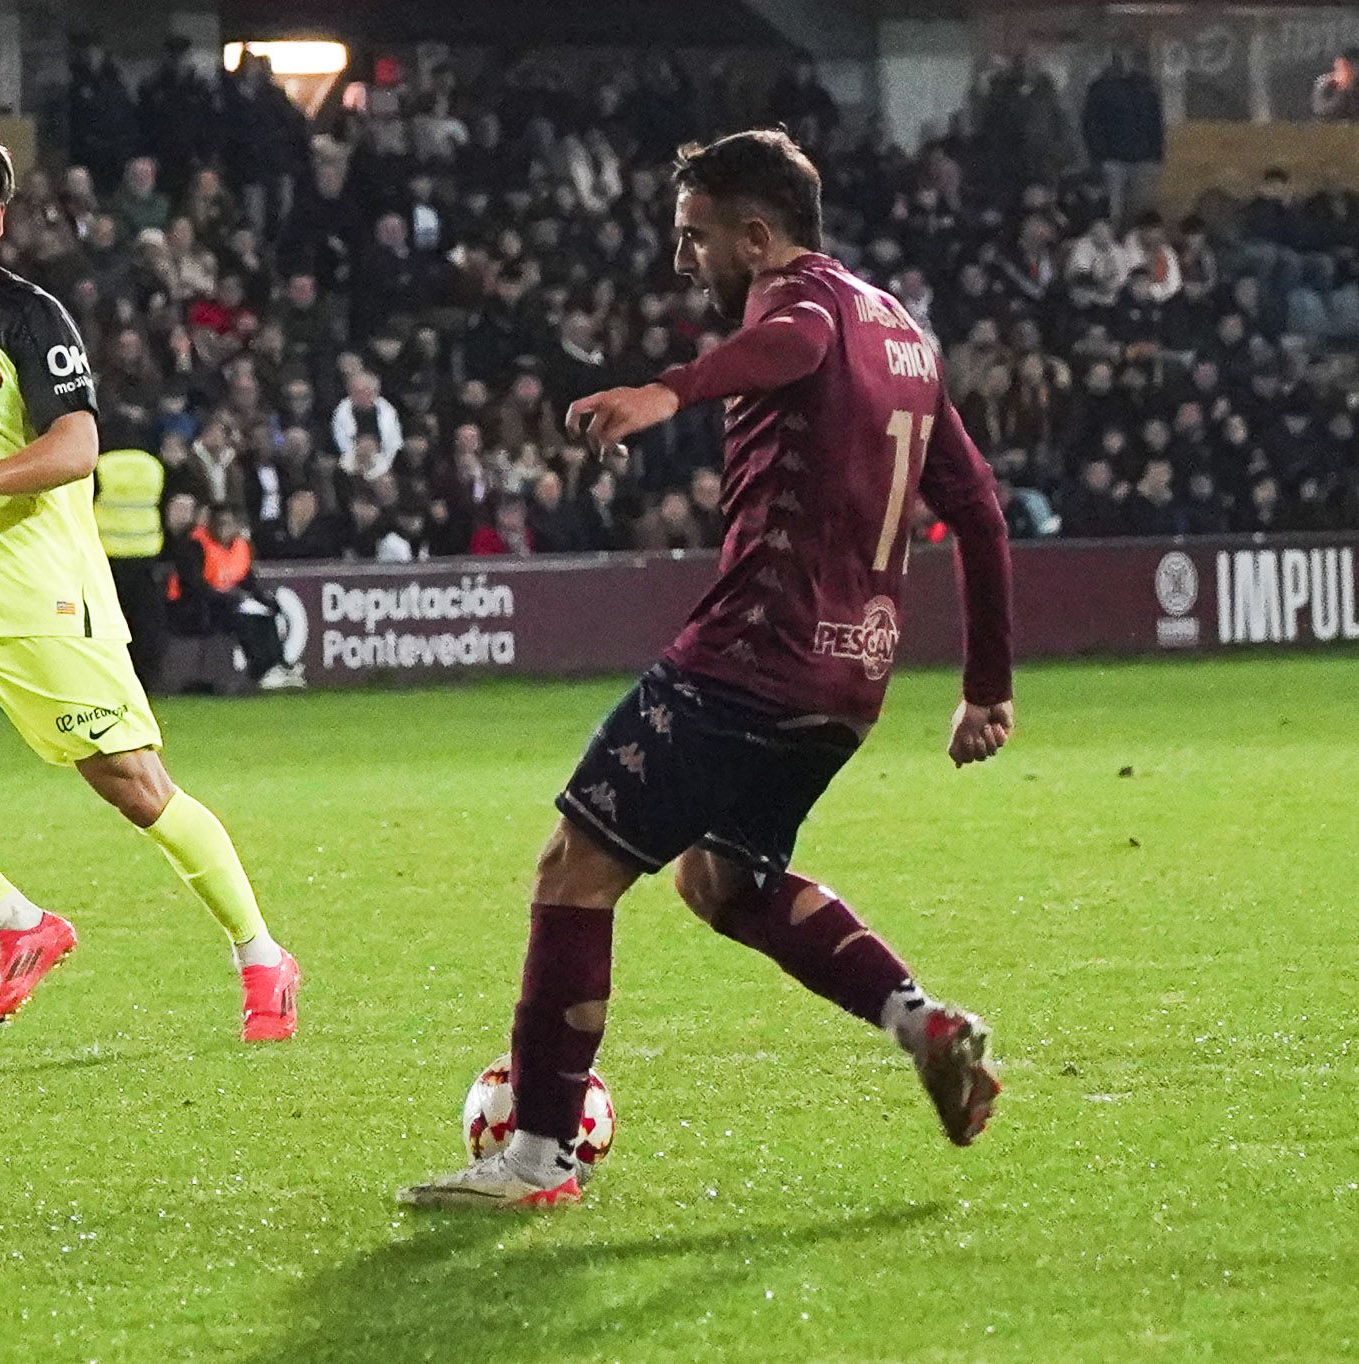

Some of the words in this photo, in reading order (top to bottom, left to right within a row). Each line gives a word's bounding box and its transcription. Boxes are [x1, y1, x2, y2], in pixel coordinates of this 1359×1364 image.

[47, 344, 91, 377] OK
[322, 573, 514, 633] Deputación
[322, 625, 515, 669] Pontevedra
